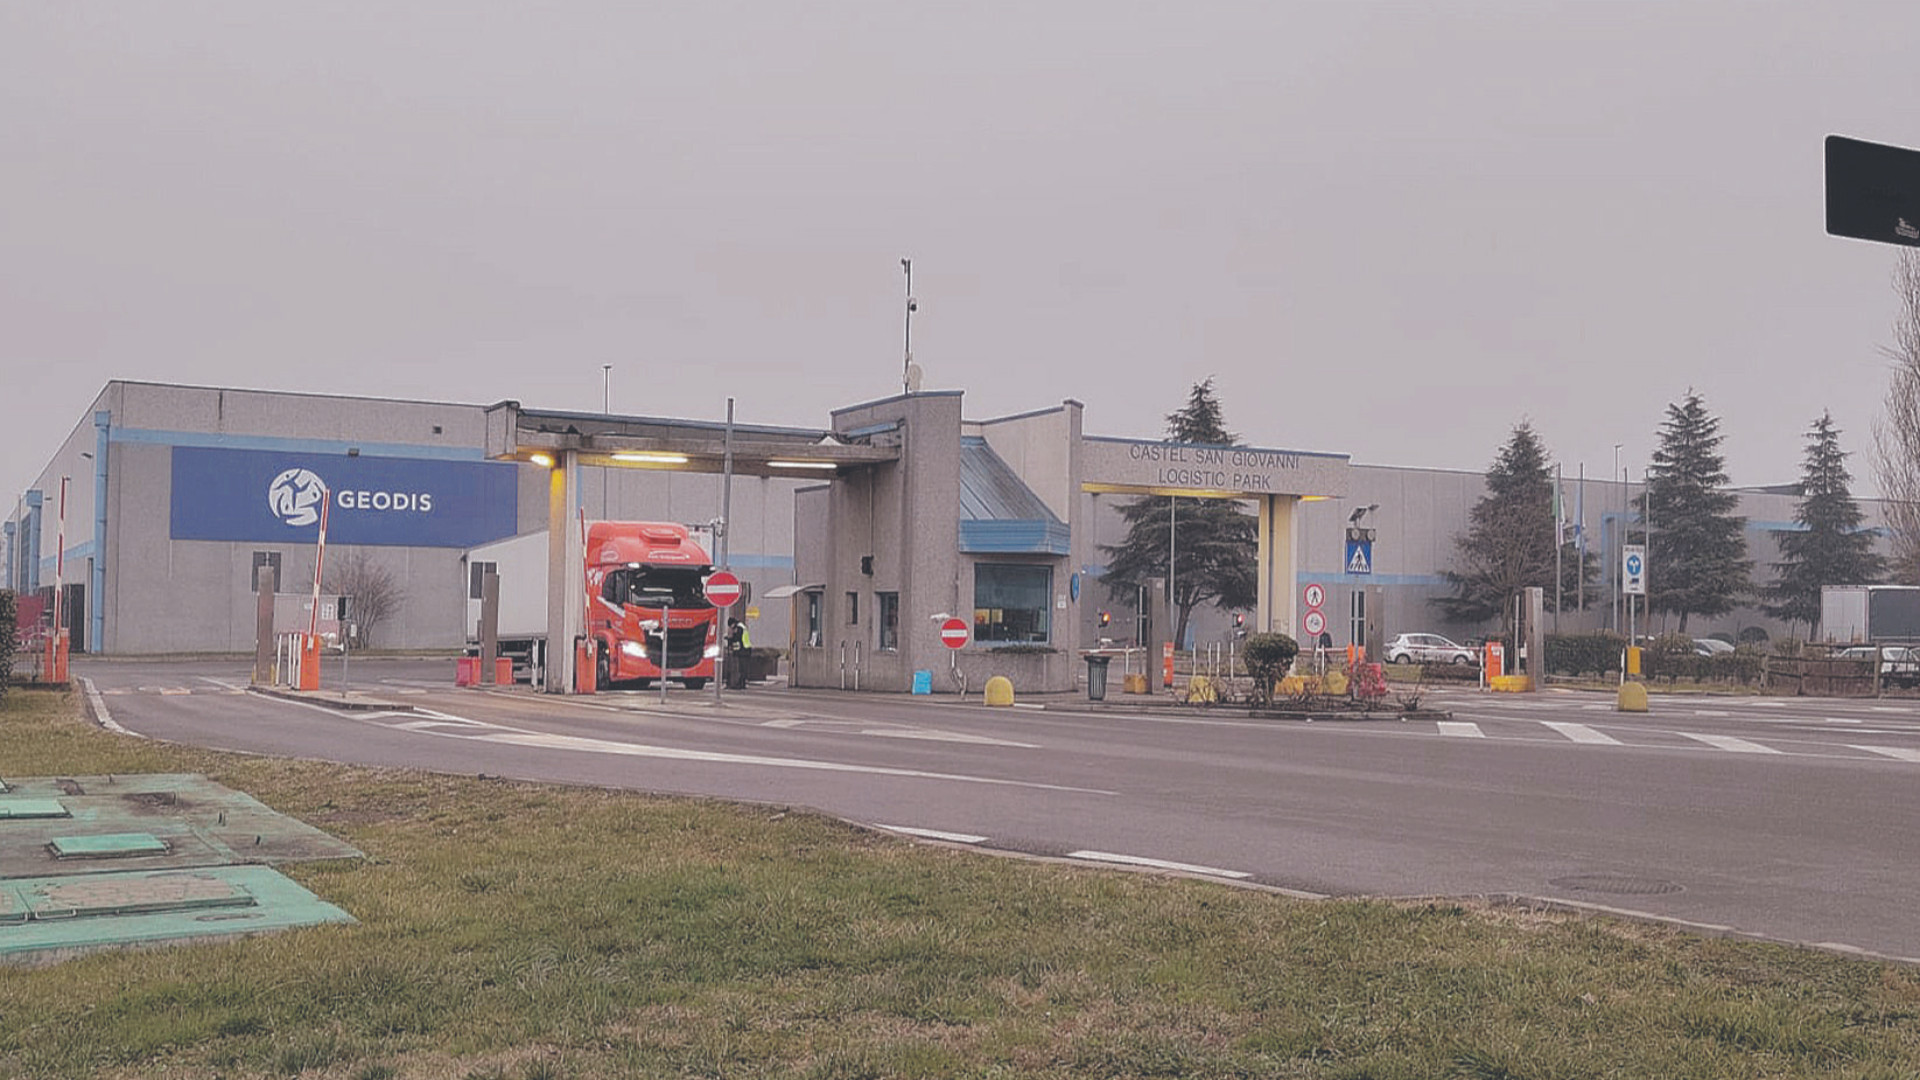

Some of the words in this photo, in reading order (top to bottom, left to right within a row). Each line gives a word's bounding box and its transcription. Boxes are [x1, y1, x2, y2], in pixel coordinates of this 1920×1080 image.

[1130, 445, 1187, 462] CASTEL
[1196, 450, 1224, 464] SAN
[1232, 453, 1299, 469] GIOVANNI
[1158, 468, 1225, 486] LOGISTIC
[1233, 473, 1271, 489] PARK
[337, 490, 432, 511] GEODIS
